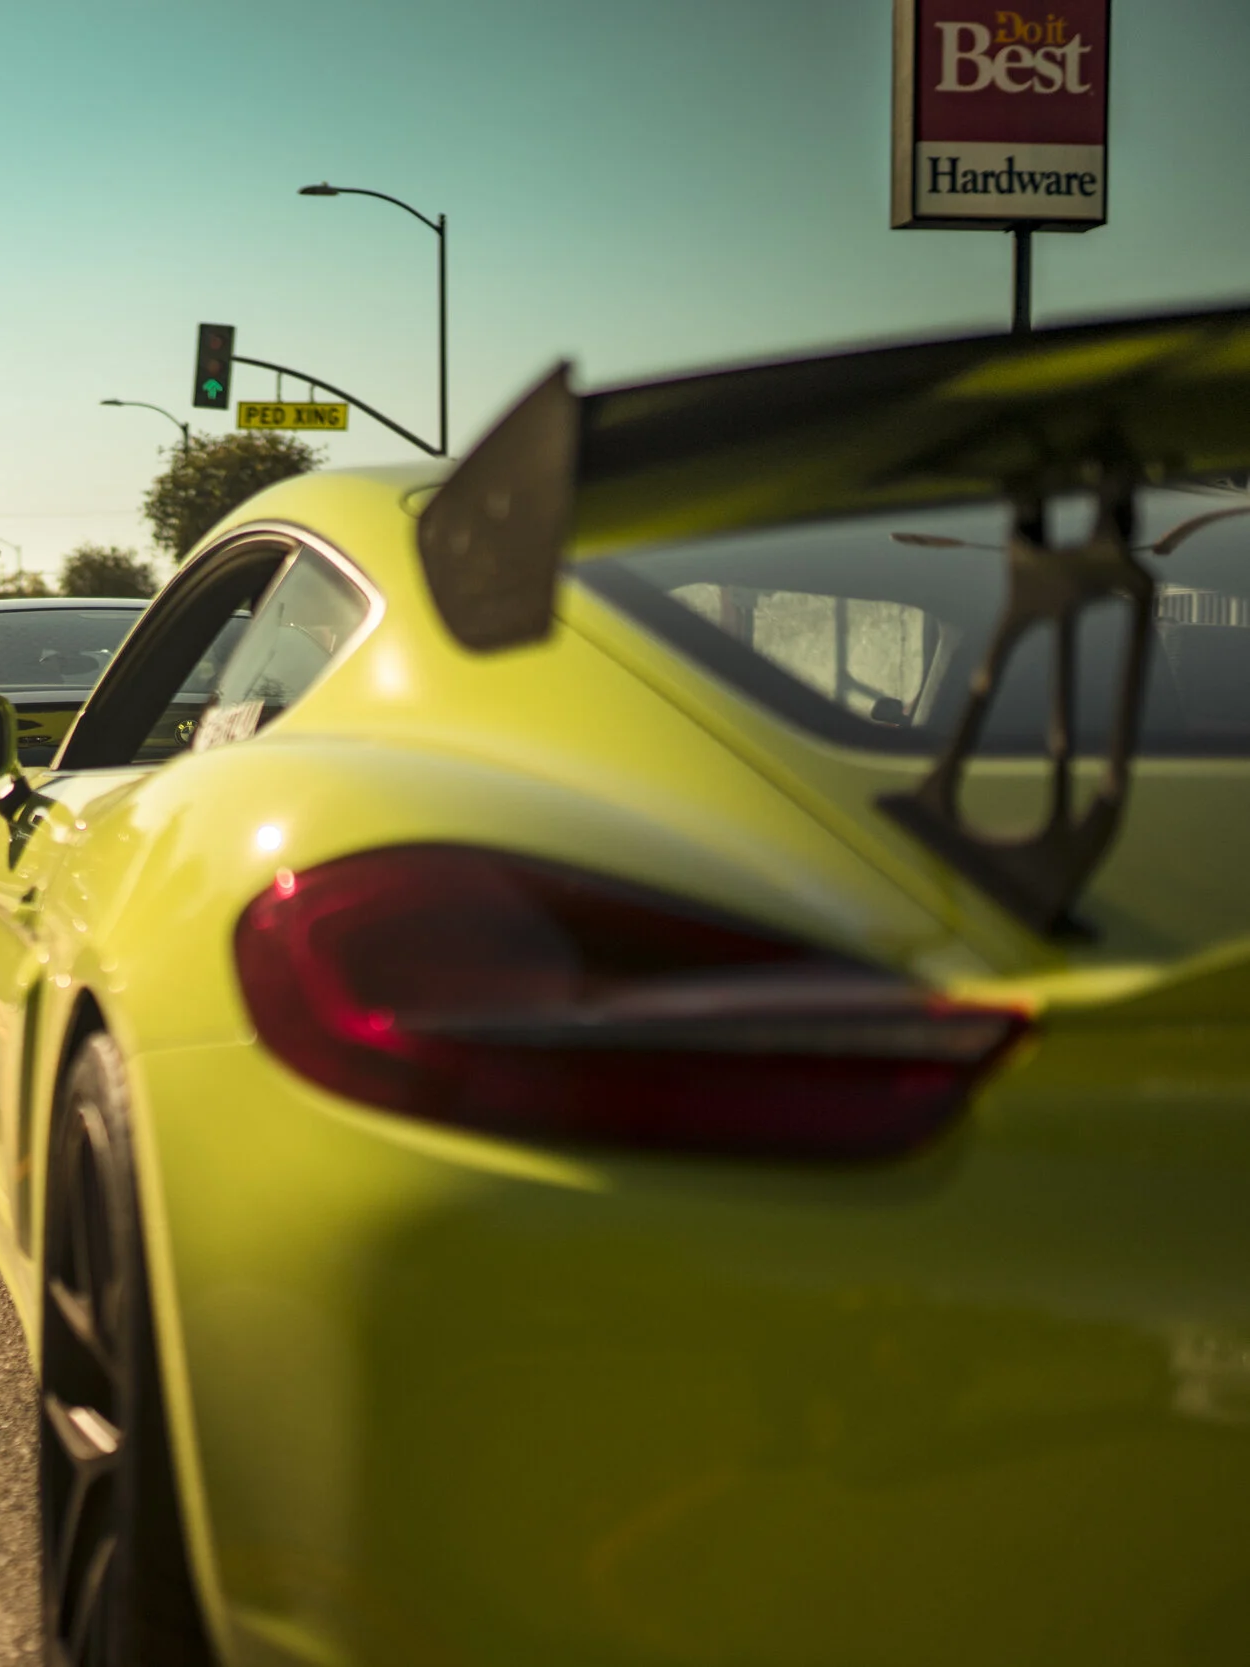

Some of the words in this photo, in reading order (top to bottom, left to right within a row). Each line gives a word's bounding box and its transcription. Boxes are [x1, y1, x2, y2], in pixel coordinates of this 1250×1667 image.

[994, 11, 1042, 44] Do
[1046, 14, 1069, 45] it
[934, 21, 1092, 94] Best
[927, 155, 1097, 197] Hardware
[244, 406, 286, 425] PED
[293, 407, 340, 426] XING
